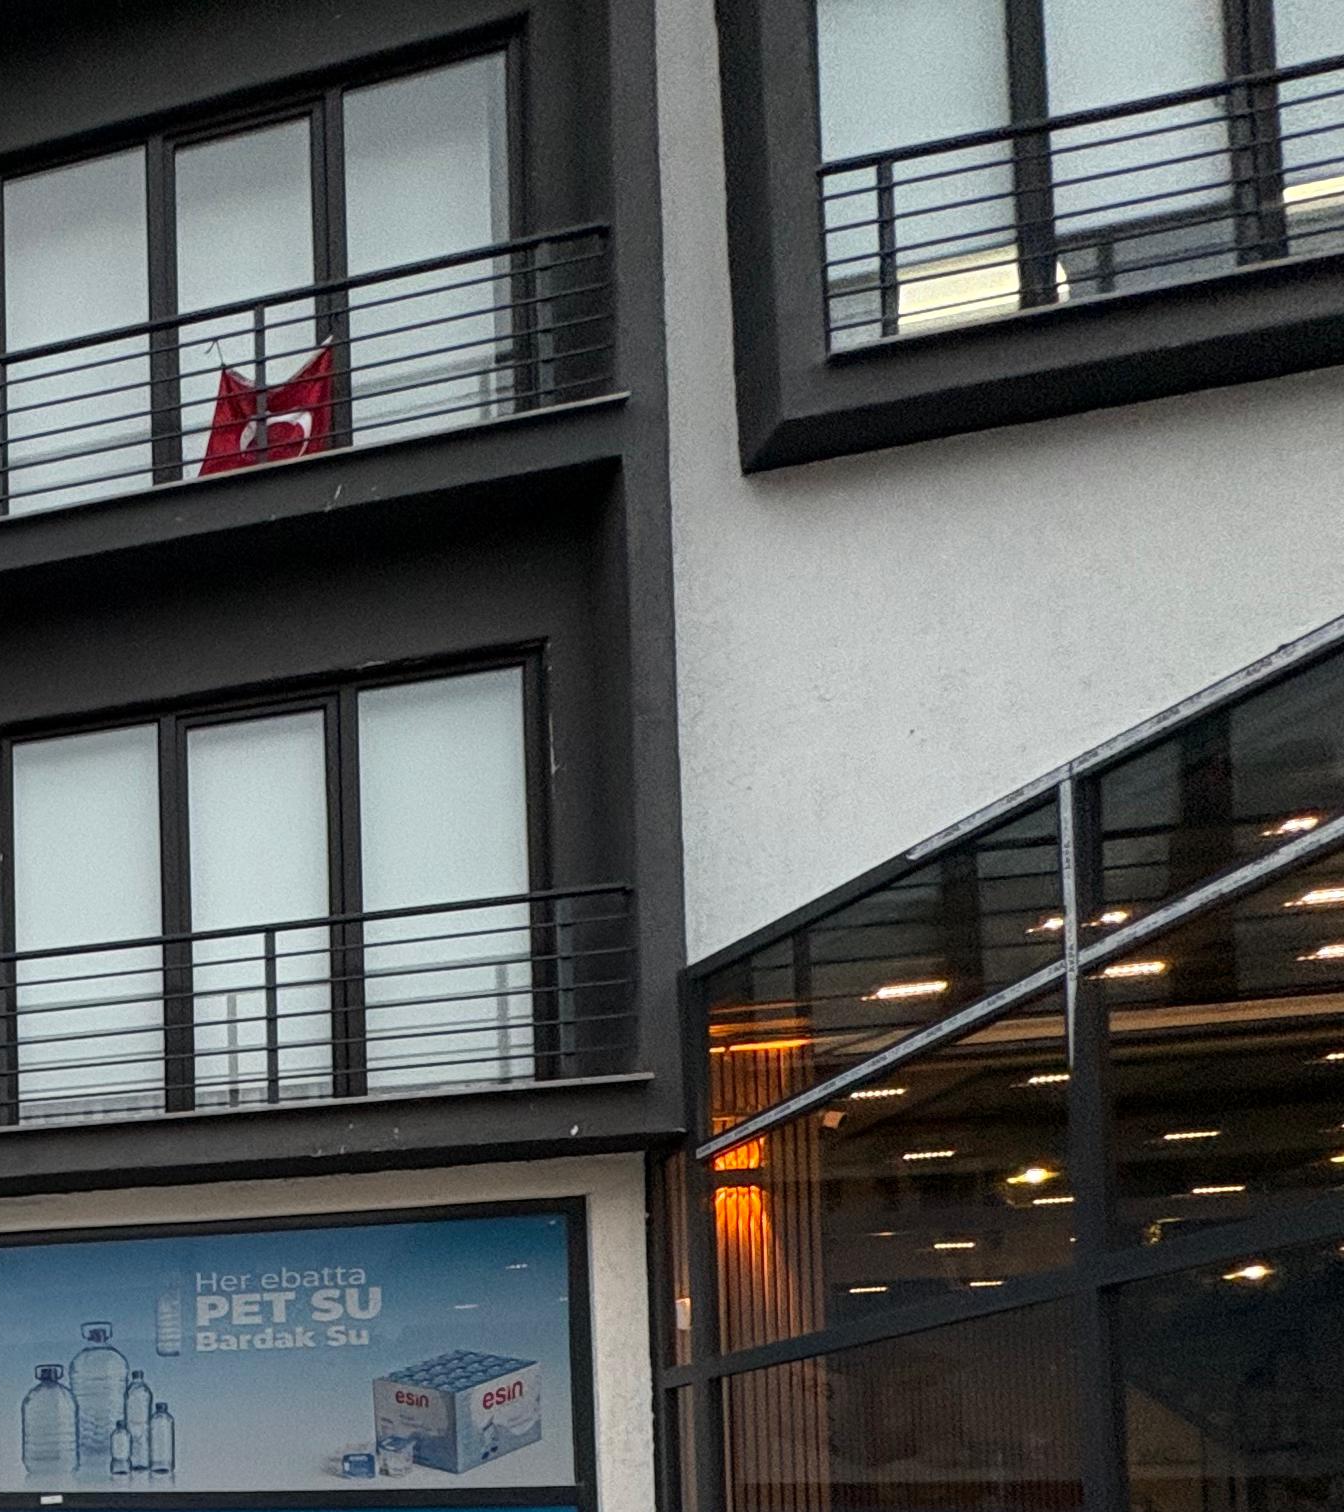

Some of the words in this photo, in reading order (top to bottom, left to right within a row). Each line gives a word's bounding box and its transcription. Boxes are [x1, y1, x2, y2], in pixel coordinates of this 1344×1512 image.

[196, 1271, 251, 1293] Her
[261, 1267, 366, 1289] ebatta
[196, 1291, 296, 1326] PET
[311, 1286, 382, 1322] SU
[196, 1327, 316, 1351] Bardak
[327, 1325, 369, 1346] Su
[395, 1390, 430, 1408] esin
[482, 1380, 524, 1410] esin
